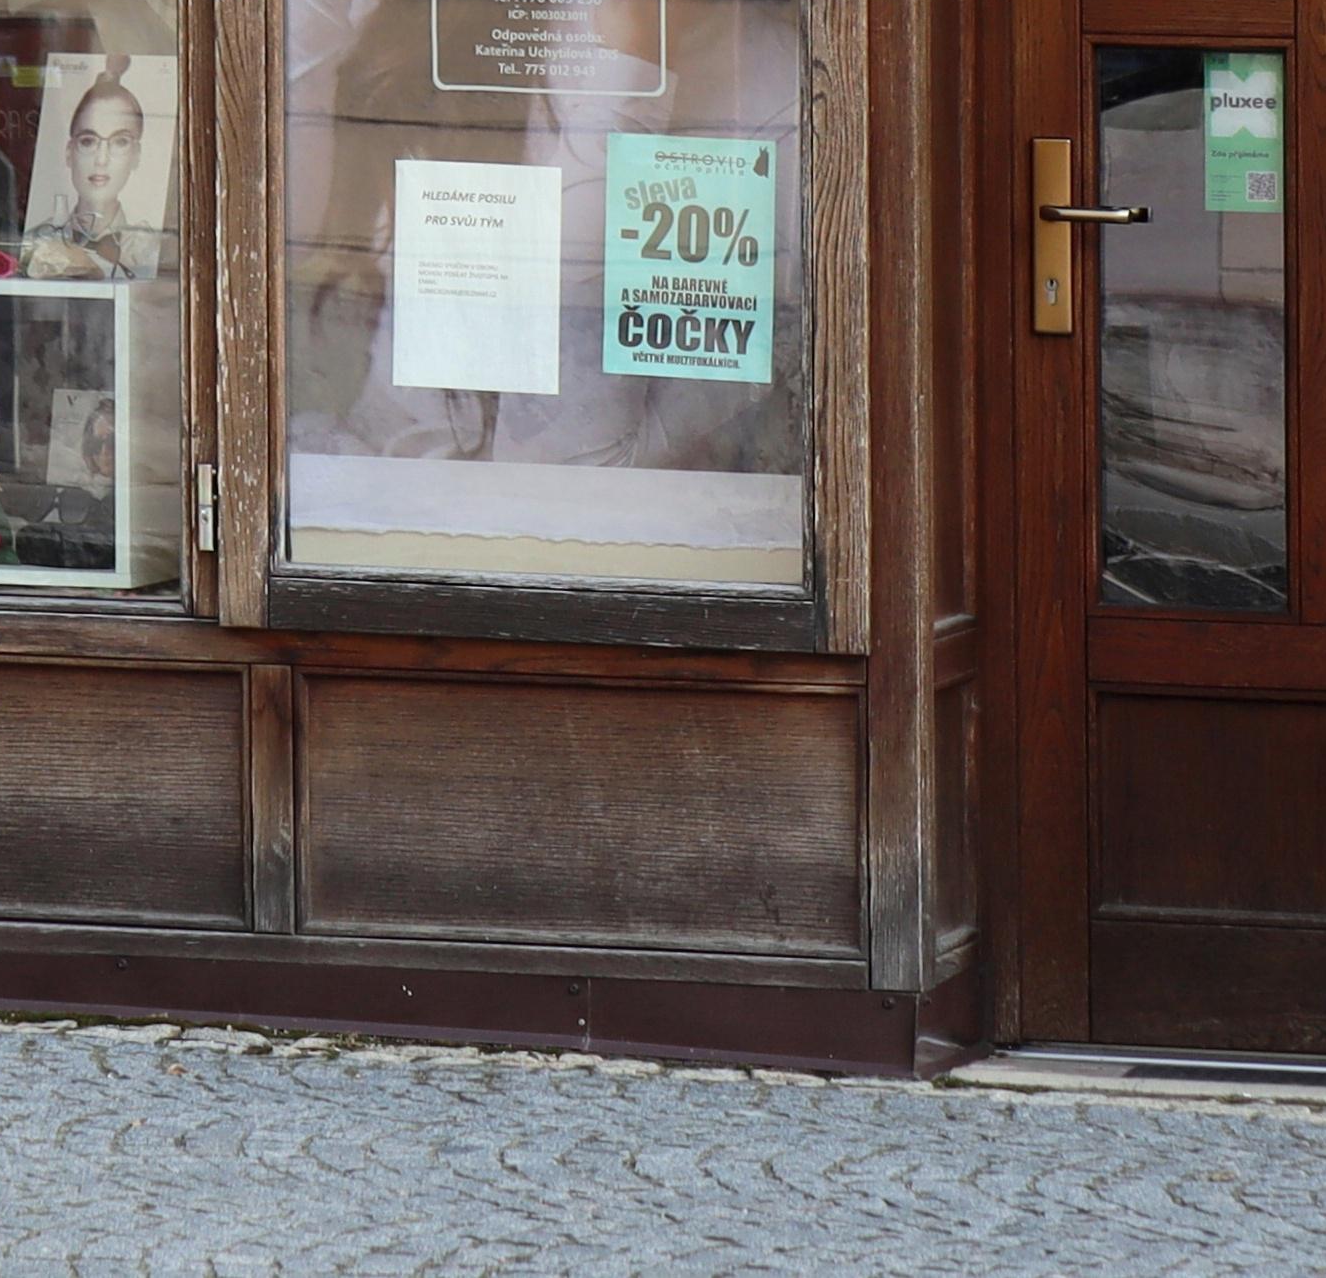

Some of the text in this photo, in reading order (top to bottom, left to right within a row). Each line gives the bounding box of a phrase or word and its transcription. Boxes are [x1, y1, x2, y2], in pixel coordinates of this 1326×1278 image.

[491, 27, 562, 43] Odpovědná
[475, 43, 525, 57] Kateřina
[524, 63, 546, 75] 775
[550, 64, 569, 76] 012
[1210, 93, 1277, 111] pluxee
[654, 151, 746, 168] OSTROVID
[654, 162, 688, 171] oční
[422, 189, 516, 205] HLEDÁME POSILU
[624, 176, 698, 210] sleva
[424, 214, 504, 228] PRO SVŮJ TÝM
[621, 202, 759, 267] -20%
[652, 276, 728, 294] NA BAREVNÉ
[621, 289, 757, 311] A SAMOZABARVOVACÍ
[618, 304, 755, 355] ČOČKY
